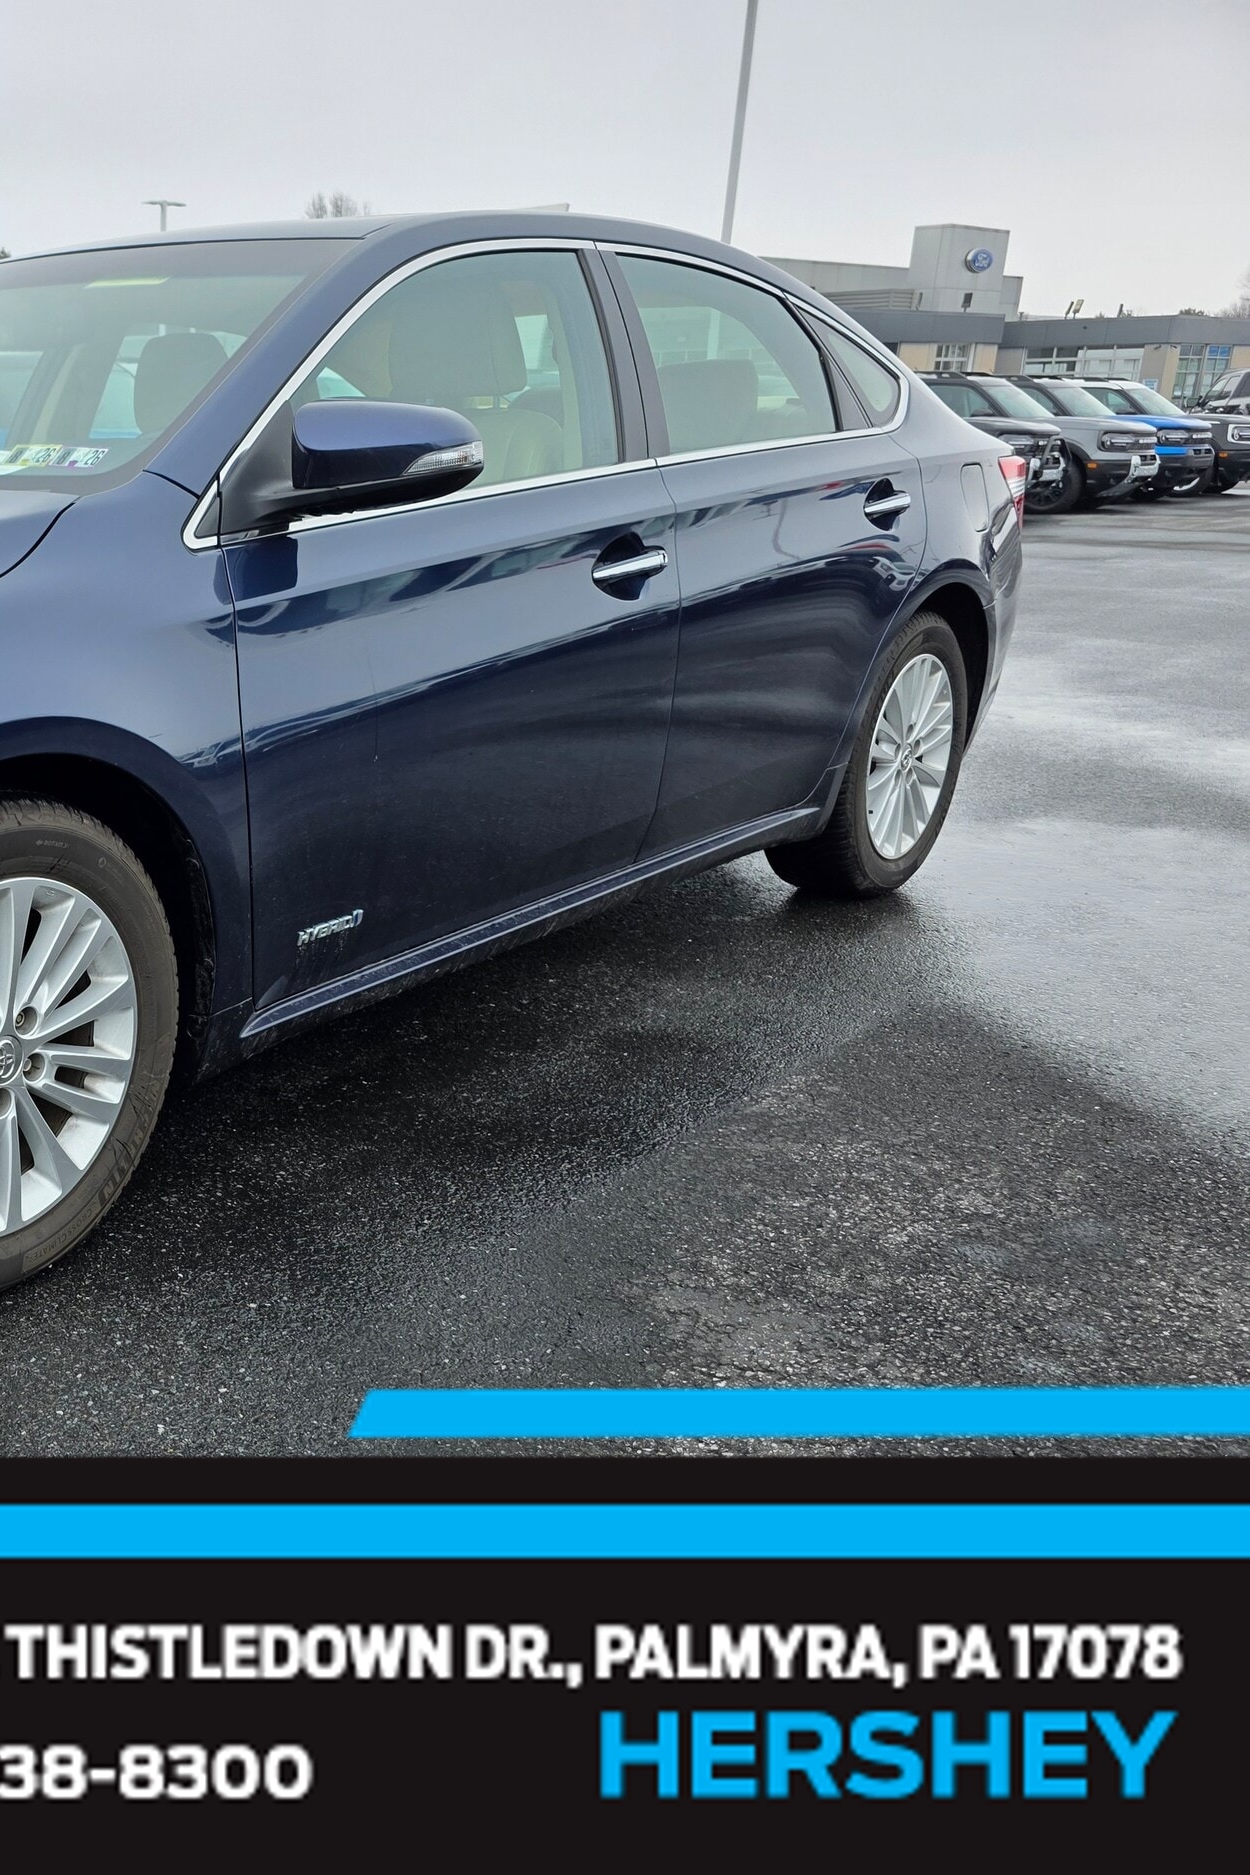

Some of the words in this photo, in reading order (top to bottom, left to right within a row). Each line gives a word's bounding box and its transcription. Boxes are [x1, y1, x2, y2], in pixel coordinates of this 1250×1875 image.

[36, 447, 56, 463] 26
[84, 449, 105, 466] 26
[297, 912, 356, 947] HYBRID
